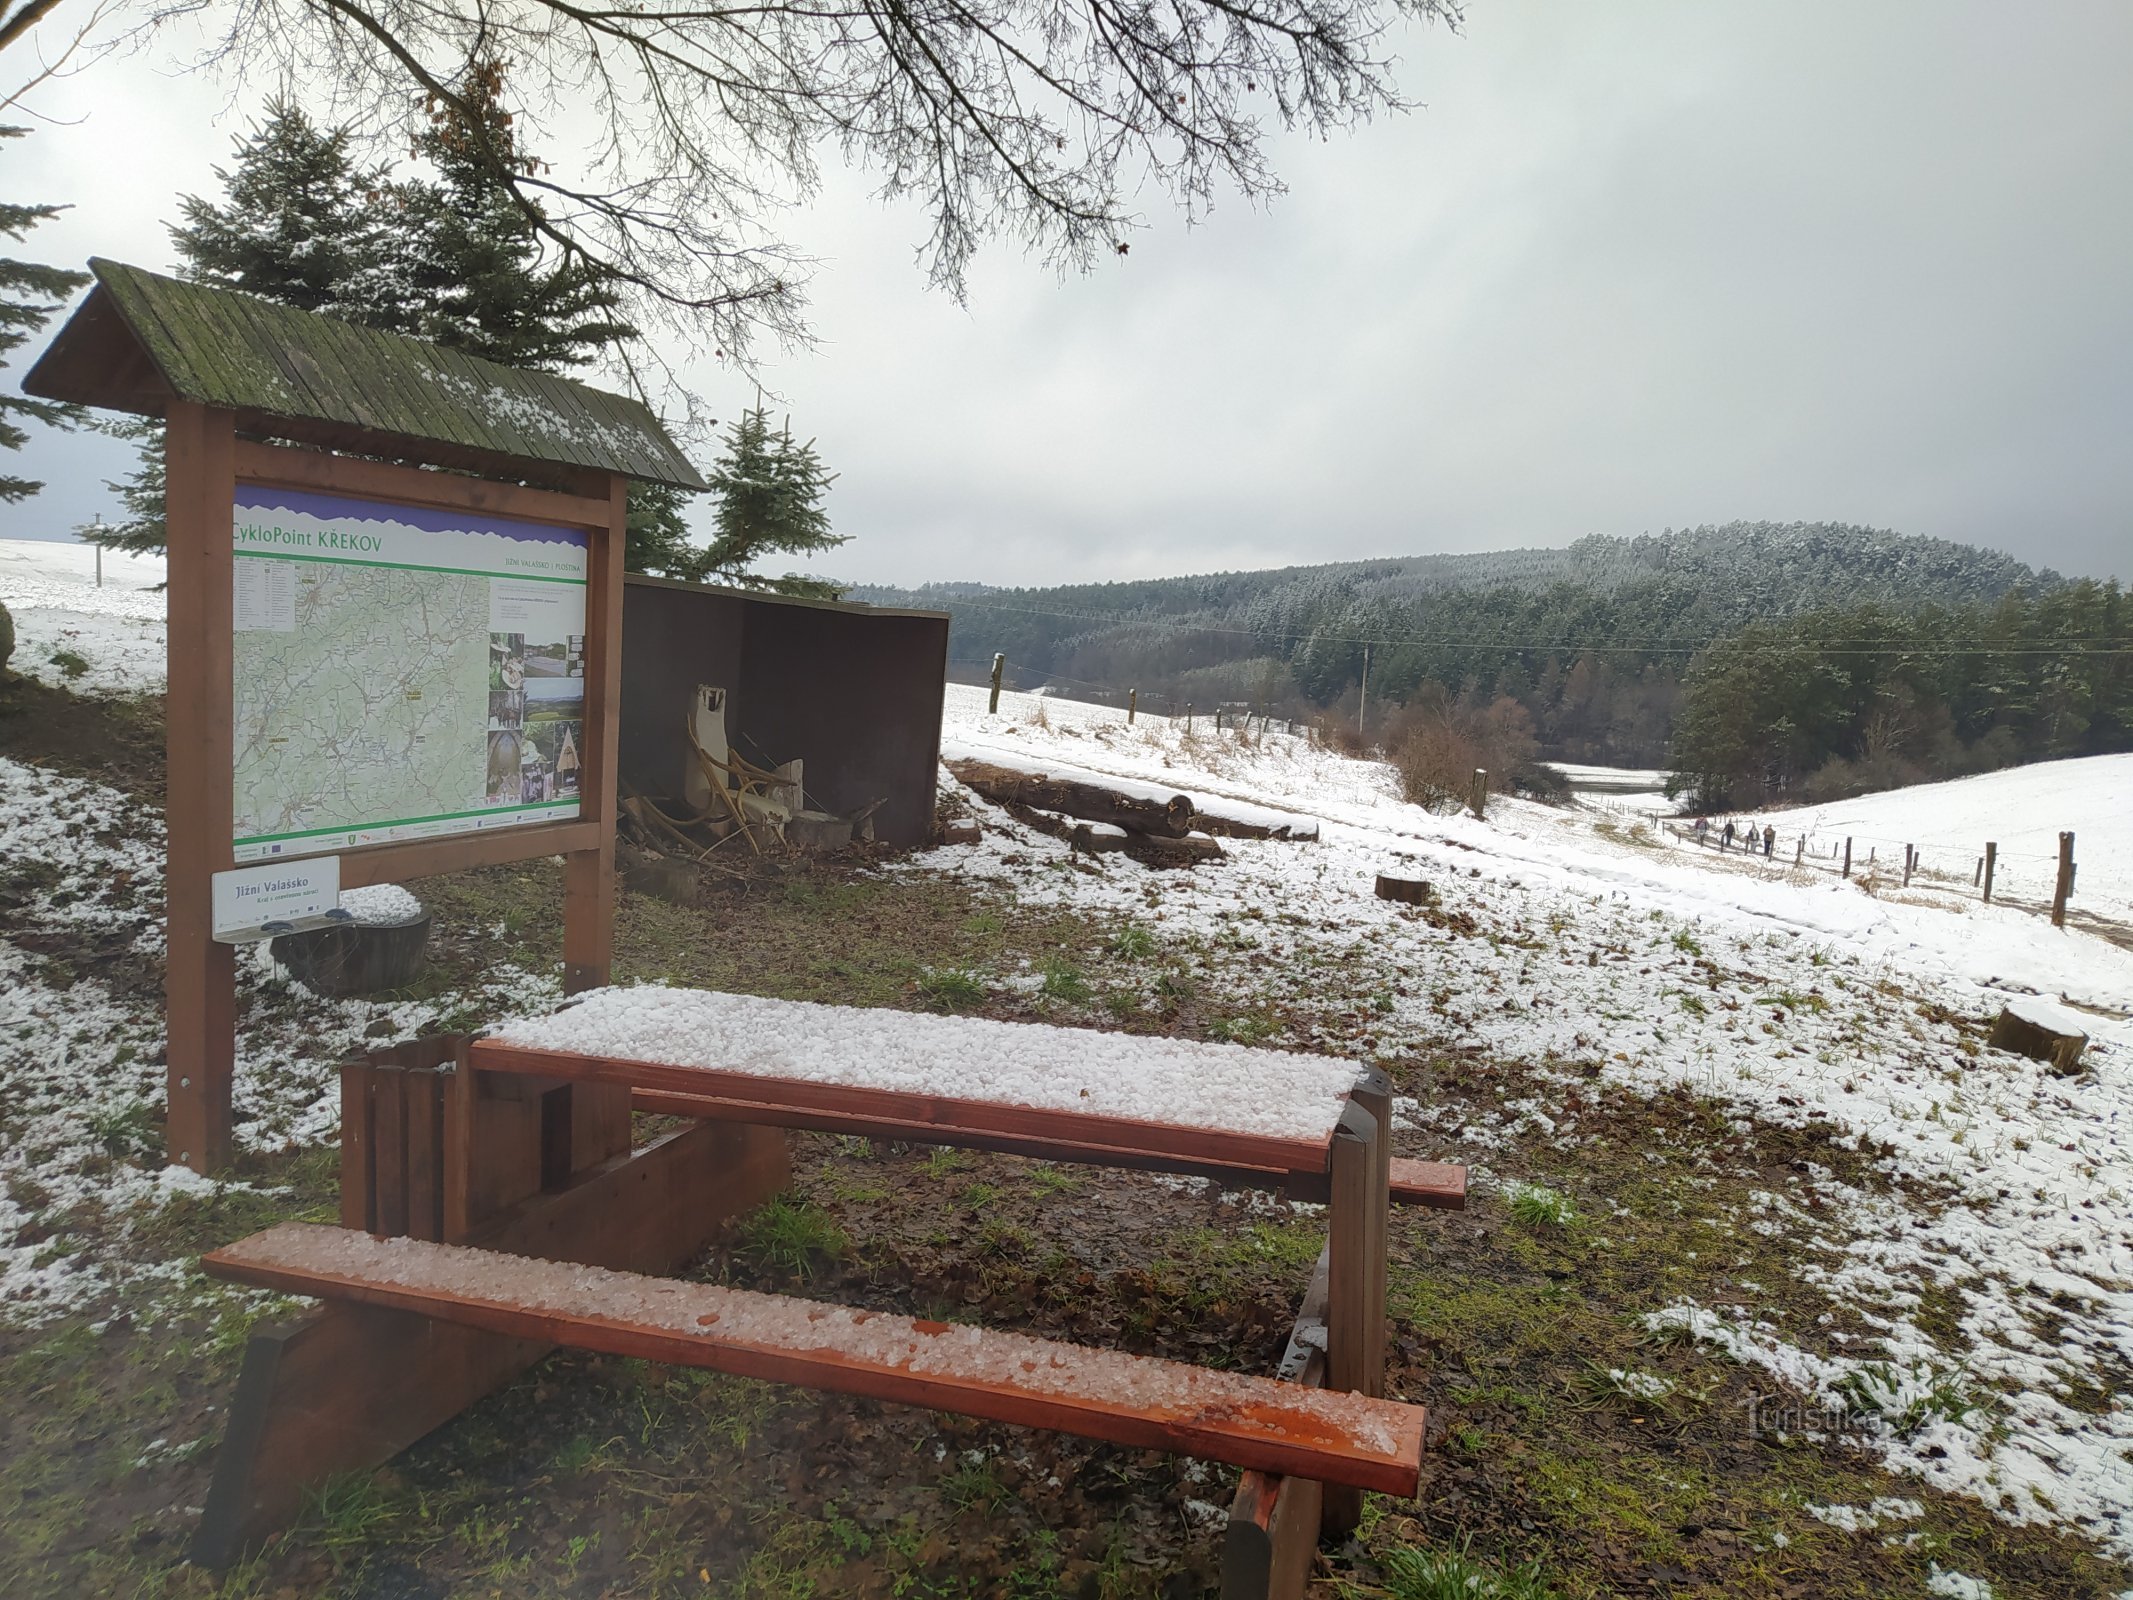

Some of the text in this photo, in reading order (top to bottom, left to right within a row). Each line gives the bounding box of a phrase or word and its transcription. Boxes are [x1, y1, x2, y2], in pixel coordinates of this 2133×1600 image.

[233, 522, 382, 552] CykloPoint KŘEKOV
[264, 877, 309, 893] Valašsko
